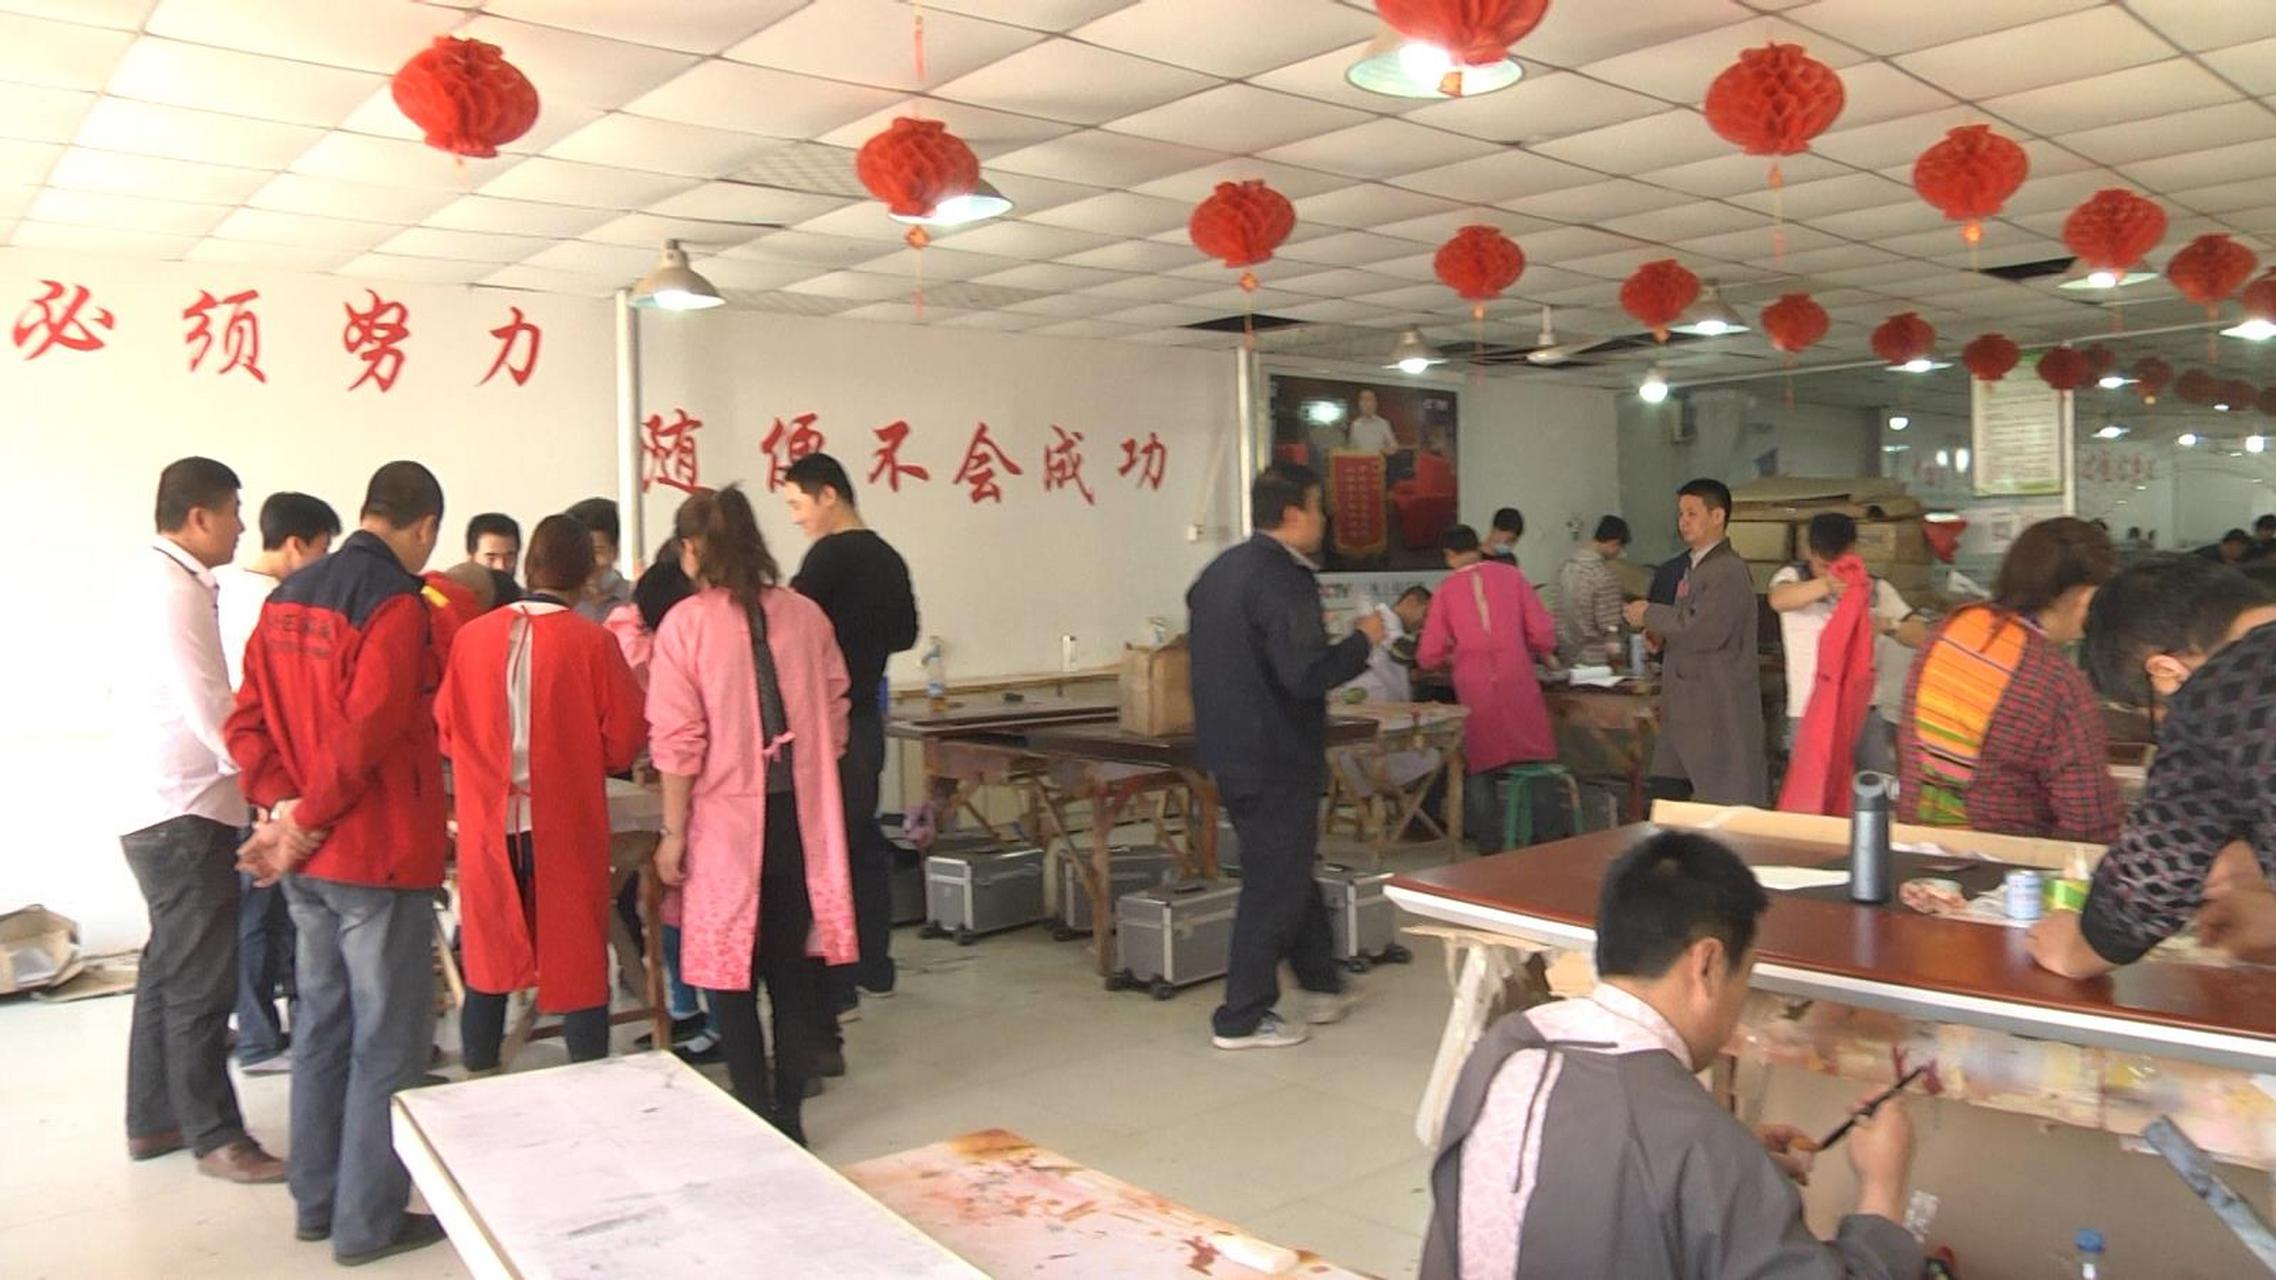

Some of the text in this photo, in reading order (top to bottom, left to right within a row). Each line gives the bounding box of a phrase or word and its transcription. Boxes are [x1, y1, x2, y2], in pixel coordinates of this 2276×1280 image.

[12, 279, 543, 392] 必须努力
[641, 408, 1169, 505] 随便不会成功
